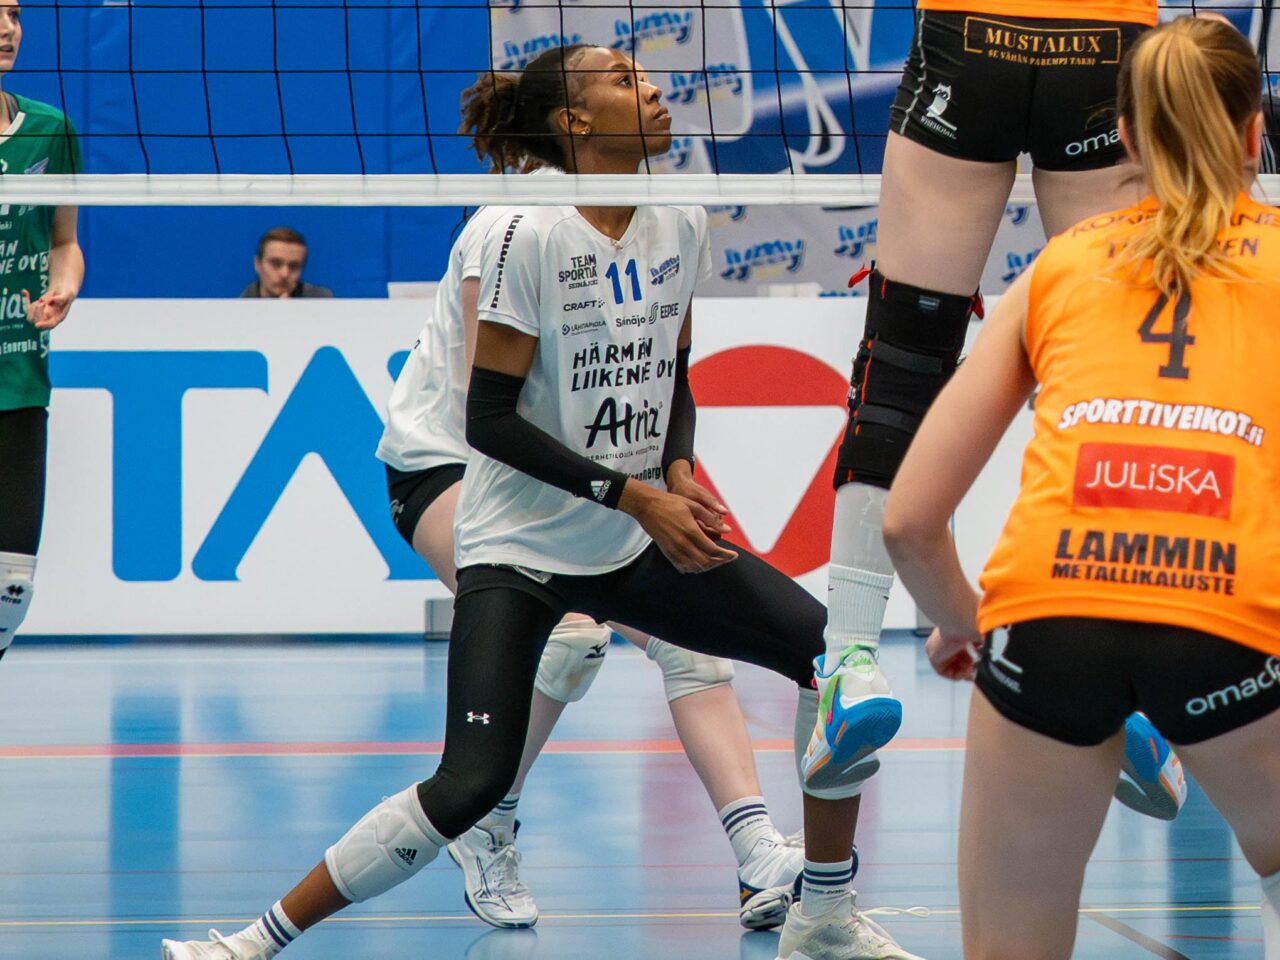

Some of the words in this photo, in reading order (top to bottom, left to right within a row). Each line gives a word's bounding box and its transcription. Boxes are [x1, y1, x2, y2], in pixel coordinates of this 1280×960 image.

[985, 27, 1101, 53] MUSTALUX
[1065, 128, 1121, 156] oma
[571, 254, 597, 268] TEAM
[605, 258, 642, 305] 11
[563, 300, 597, 311] CRAFT
[1137, 277, 1195, 380] 4
[572, 337, 653, 369] HÄRMÄN
[657, 357, 676, 379] OY
[1056, 397, 1265, 447] SPORTTIVEIKOT.fi
[1054, 528, 1237, 575] LAMMIN
[1051, 562, 1235, 596] METALLIKALUSTE
